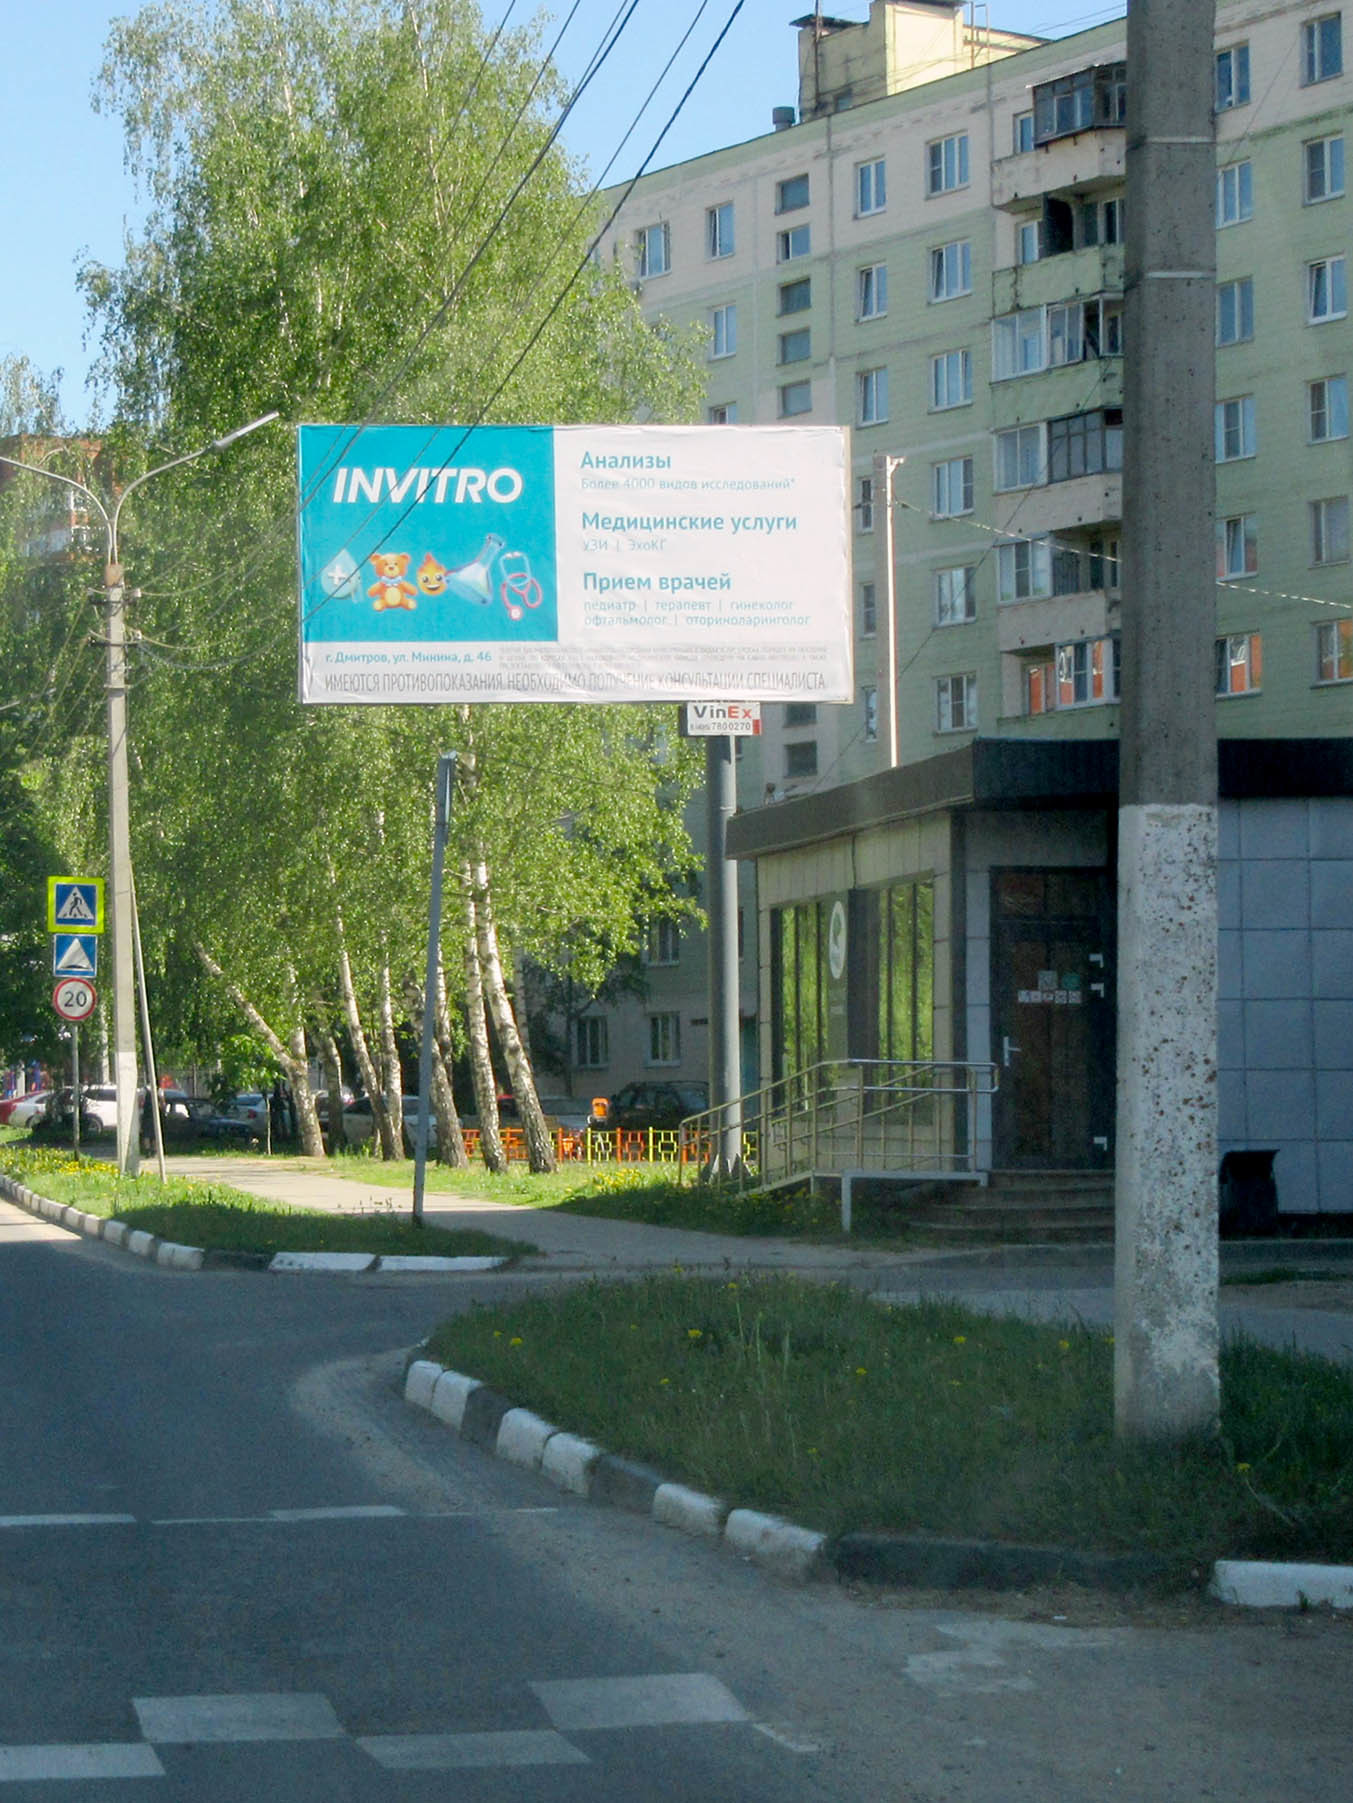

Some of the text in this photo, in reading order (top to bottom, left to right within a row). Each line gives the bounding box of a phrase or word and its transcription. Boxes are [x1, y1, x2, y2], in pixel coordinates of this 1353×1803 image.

[580, 451, 671, 469] Анализы
[332, 467, 523, 504] INVITRO
[581, 478, 619, 489] Более
[623, 478, 655, 489] 4000
[659, 480, 697, 491] видов
[581, 512, 797, 534] Медицинские услуги
[584, 572, 731, 594] Прием врачей
[584, 600, 794, 612] педиатр терапевт гинеколог
[585, 614, 810, 627] офтальмолог оториноларинголог
[335, 652, 391, 665] Дмитров,
[393, 653, 407, 665] ул.
[412, 652, 461, 664] Минина,
[477, 652, 492, 662] 46
[325, 672, 380, 692] ИМЕЮТСЯ
[694, 705, 752, 719] VinEx
[64, 991, 87, 1007] 20
